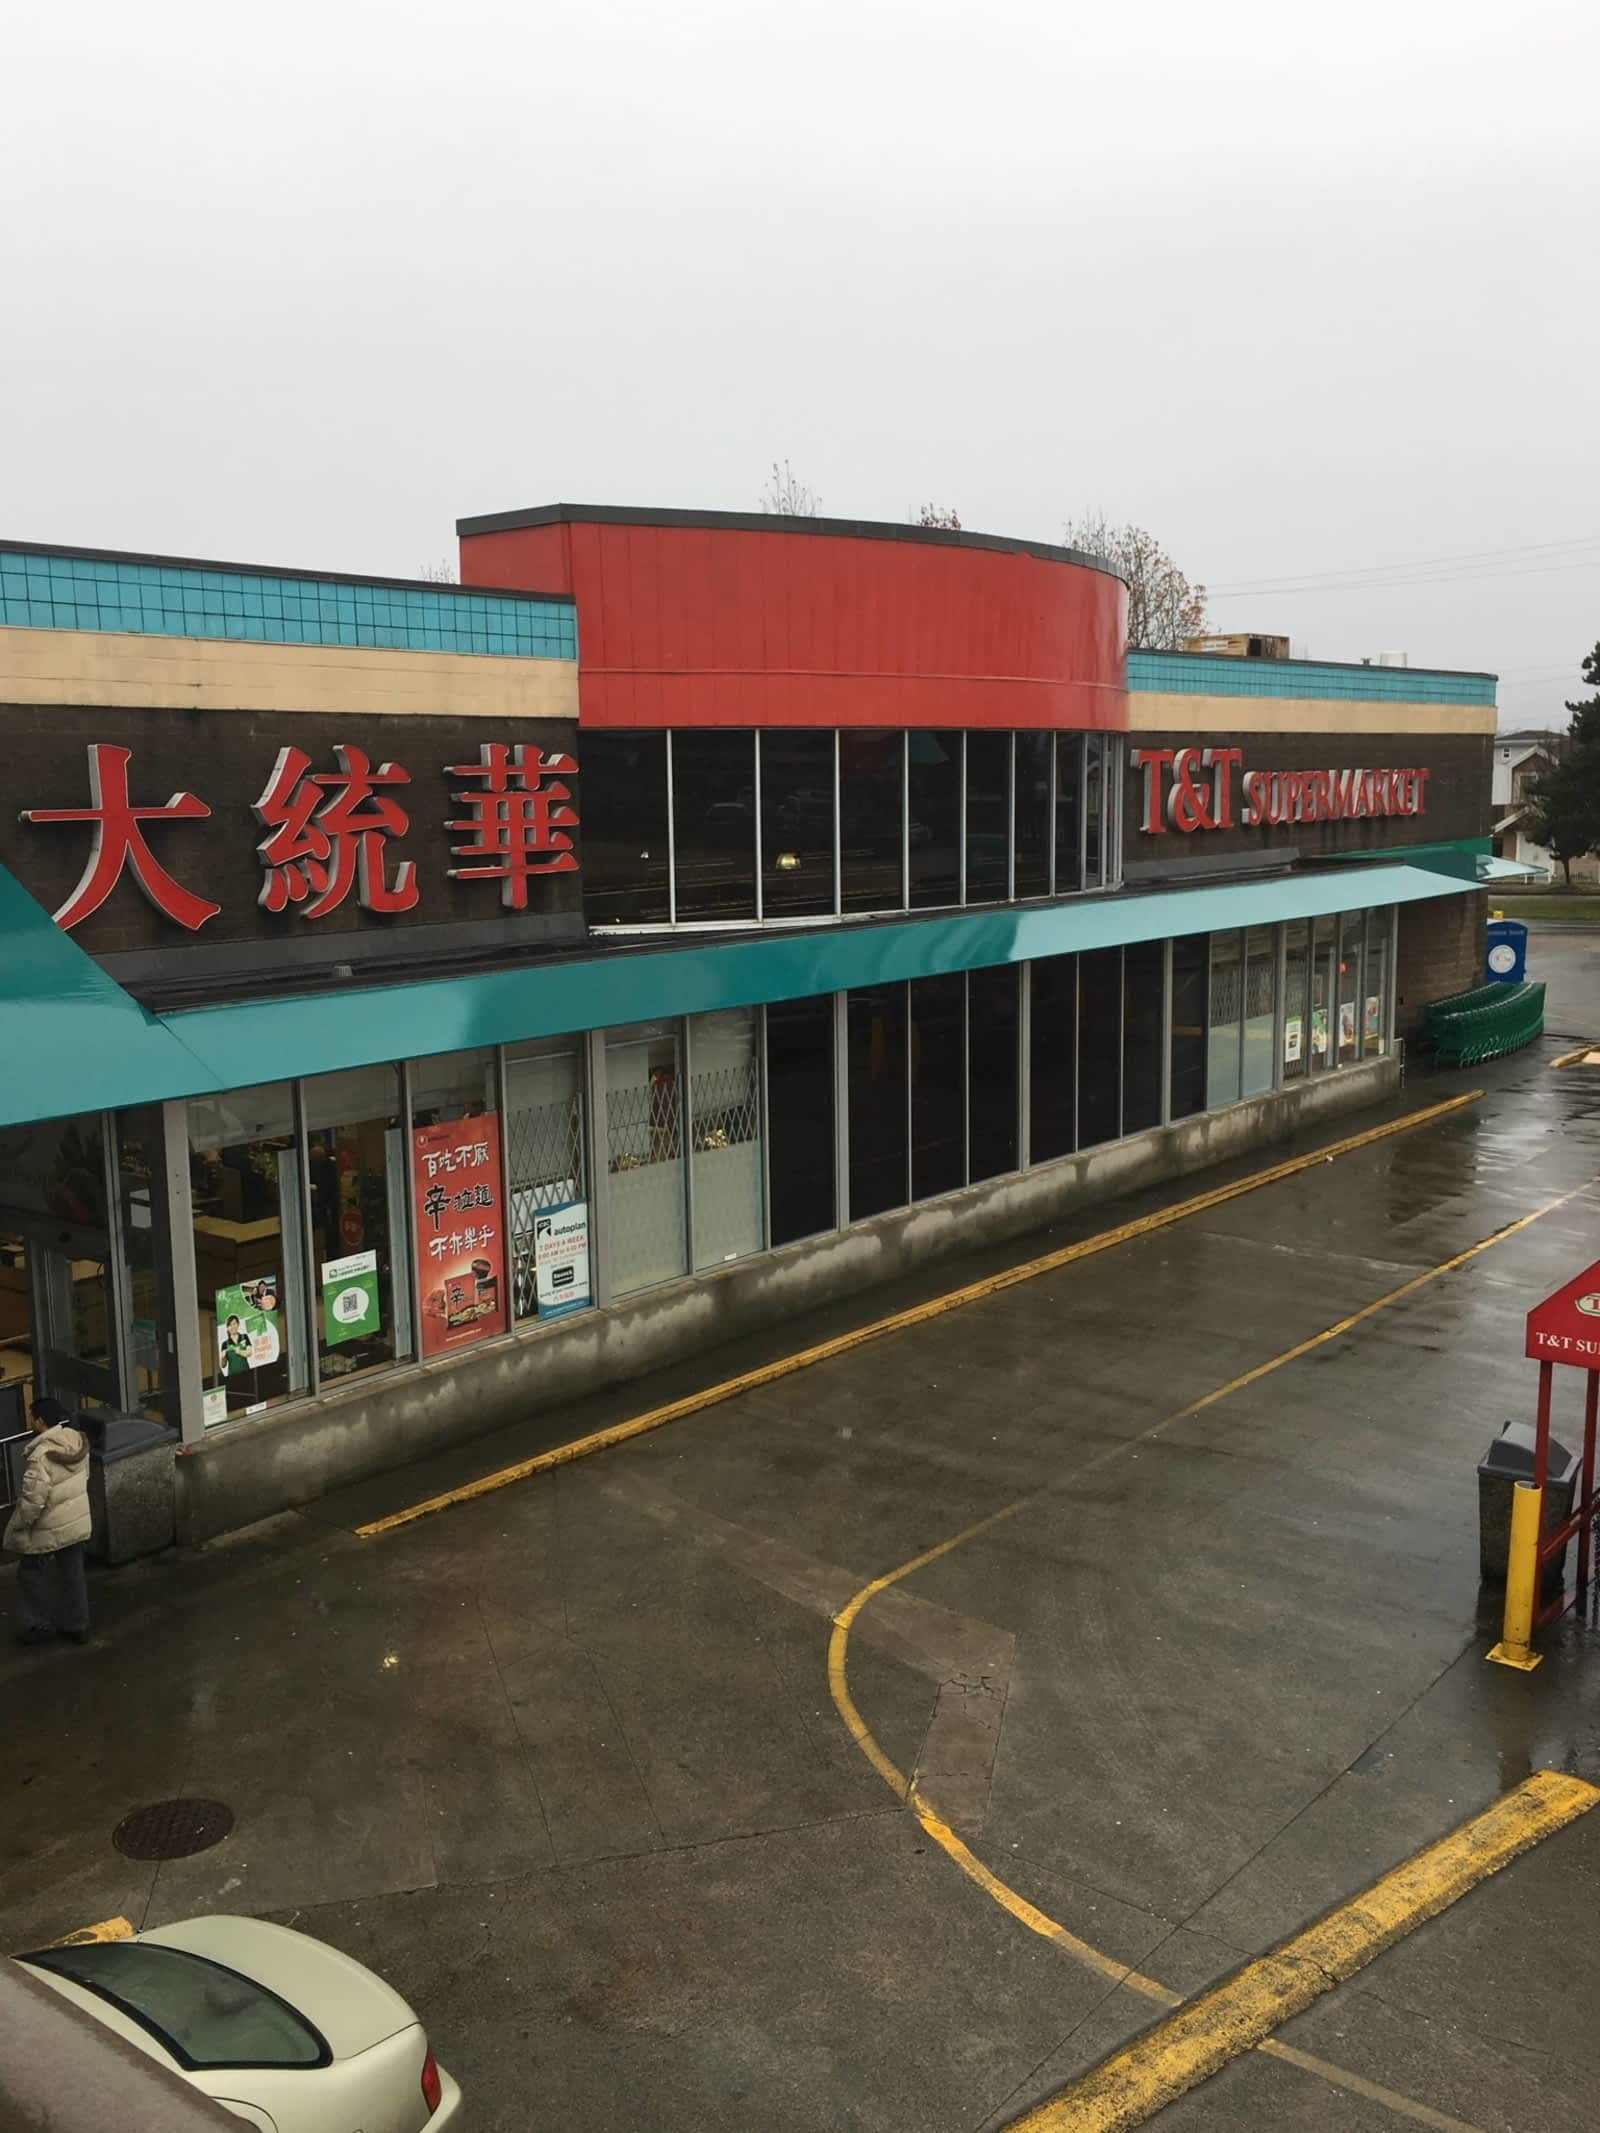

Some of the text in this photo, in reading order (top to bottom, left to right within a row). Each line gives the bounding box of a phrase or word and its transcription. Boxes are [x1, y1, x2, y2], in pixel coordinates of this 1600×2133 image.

[1131, 747, 1430, 834] T&T SUPERMARKET
[18, 743, 580, 931] 大統華
[554, 1221, 586, 1236] autoplan
[1535, 1331, 1573, 1349] T&T
